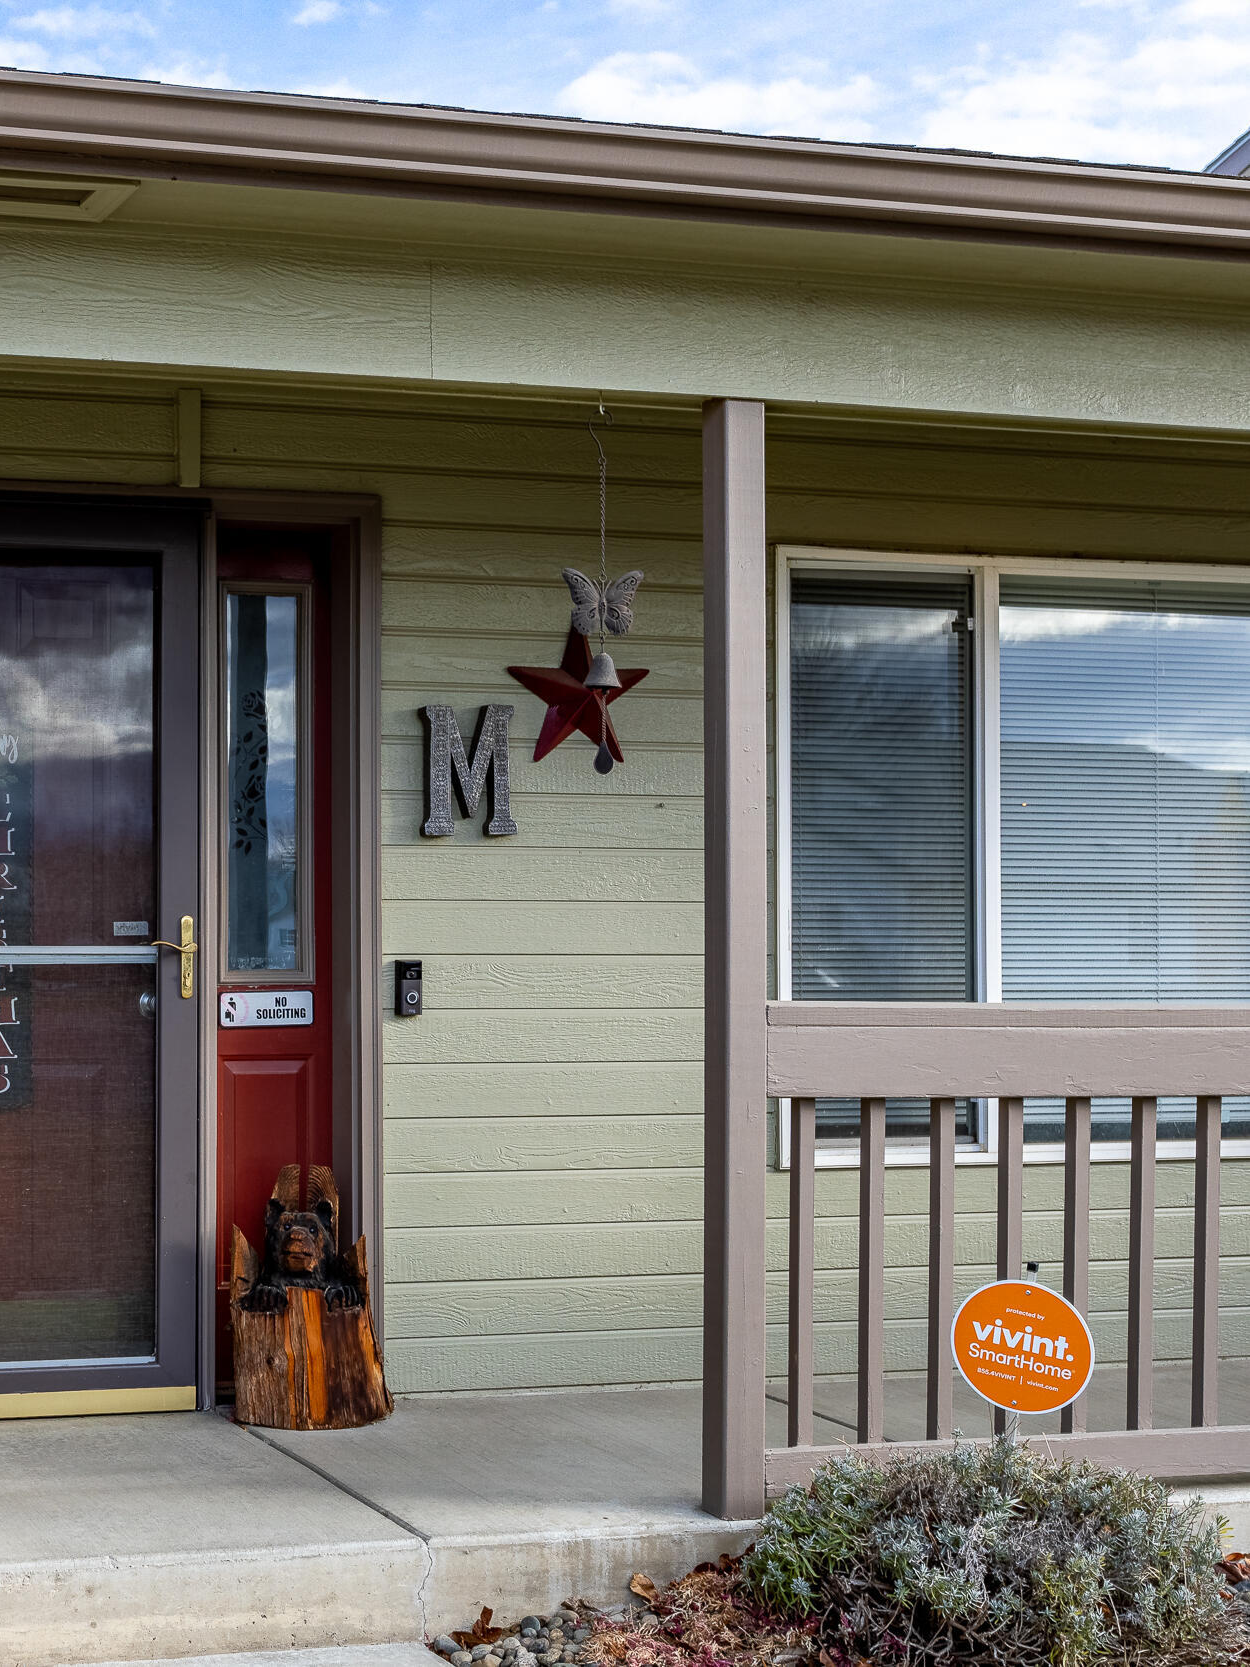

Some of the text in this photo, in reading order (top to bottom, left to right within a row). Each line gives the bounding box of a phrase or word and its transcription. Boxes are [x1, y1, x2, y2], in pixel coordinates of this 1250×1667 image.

[418, 704, 518, 837] M
[274, 996, 288, 1008] NO
[256, 1007, 306, 1020] SOLICITING
[1005, 1307, 1046, 1321] protected by
[1026, 1380, 1059, 1393] vivint.com
